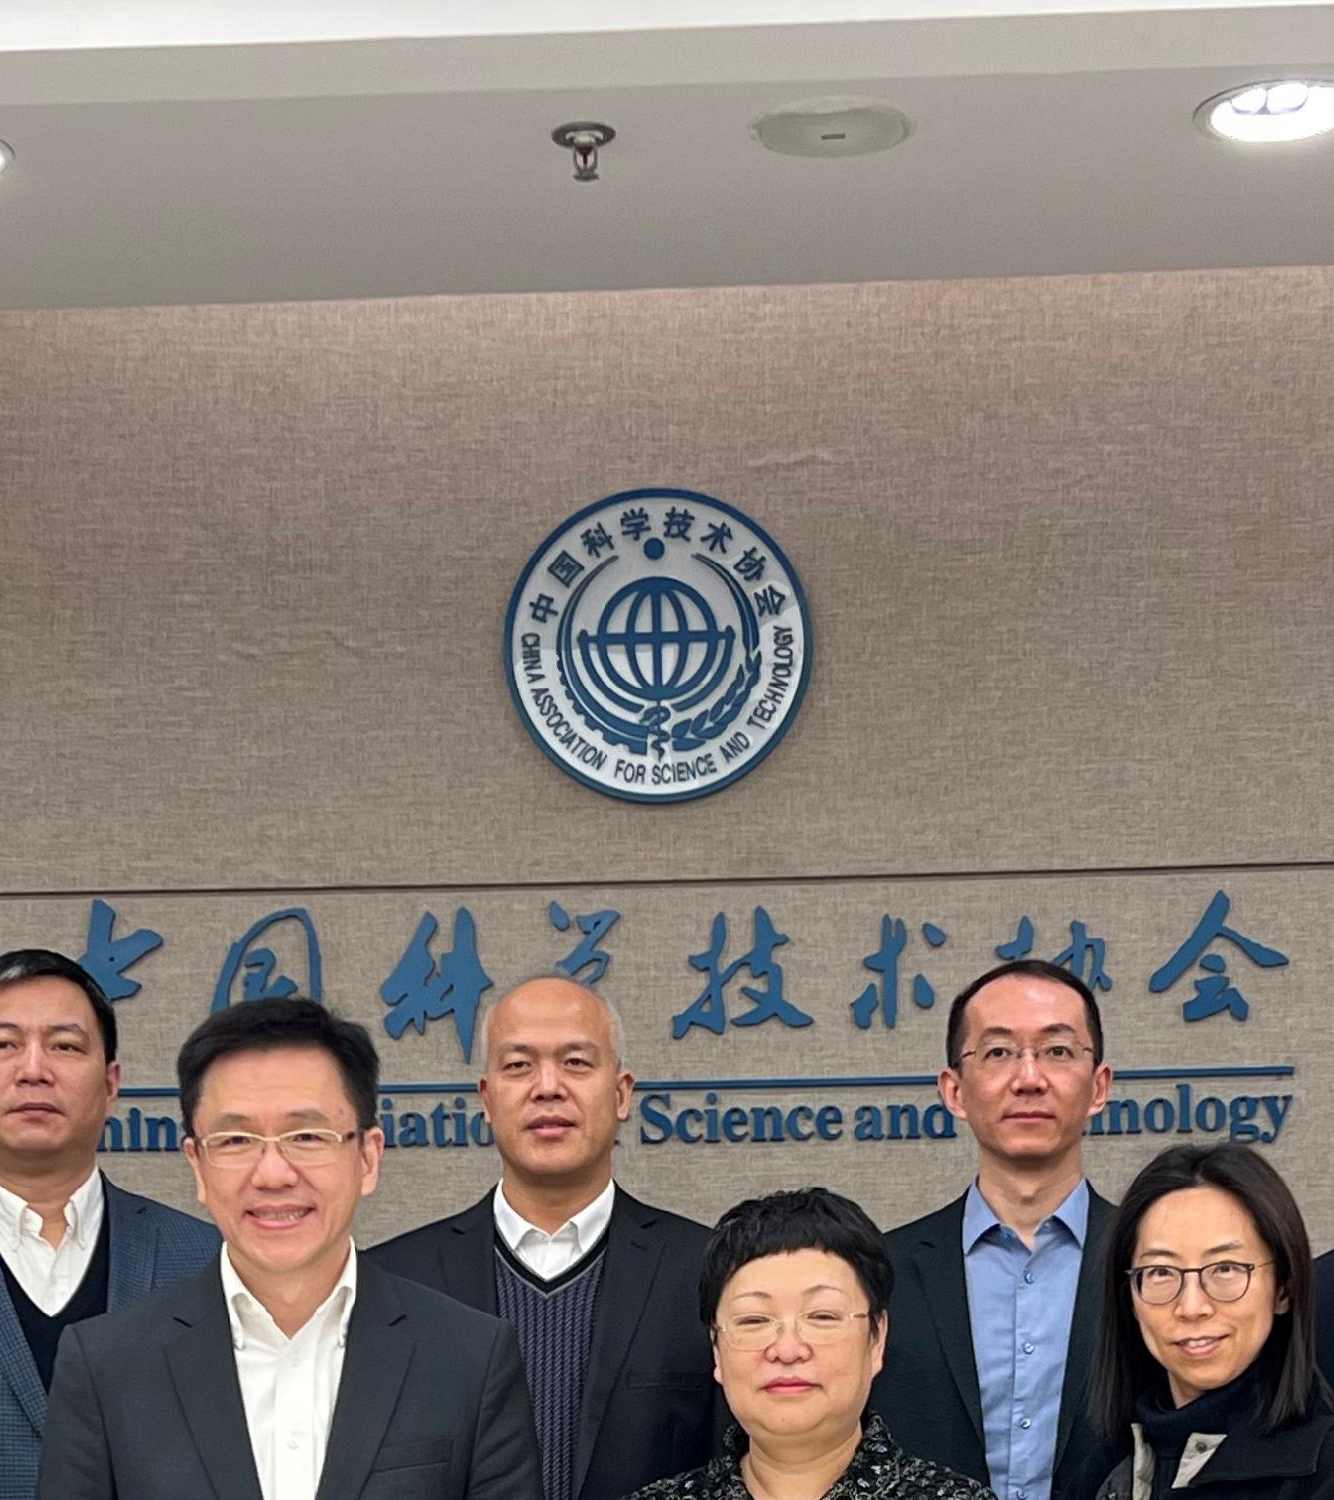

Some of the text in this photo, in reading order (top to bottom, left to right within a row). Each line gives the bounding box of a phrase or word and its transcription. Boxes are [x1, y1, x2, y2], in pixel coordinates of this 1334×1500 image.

[529, 507, 786, 625] 中国科学技术协会
[521, 625, 794, 785] CHINA ASSOCIATION FOR SCIENCE AND TECHNOLOGY
[640, 1092, 843, 1144] Science
[854, 1102, 957, 1141] and
